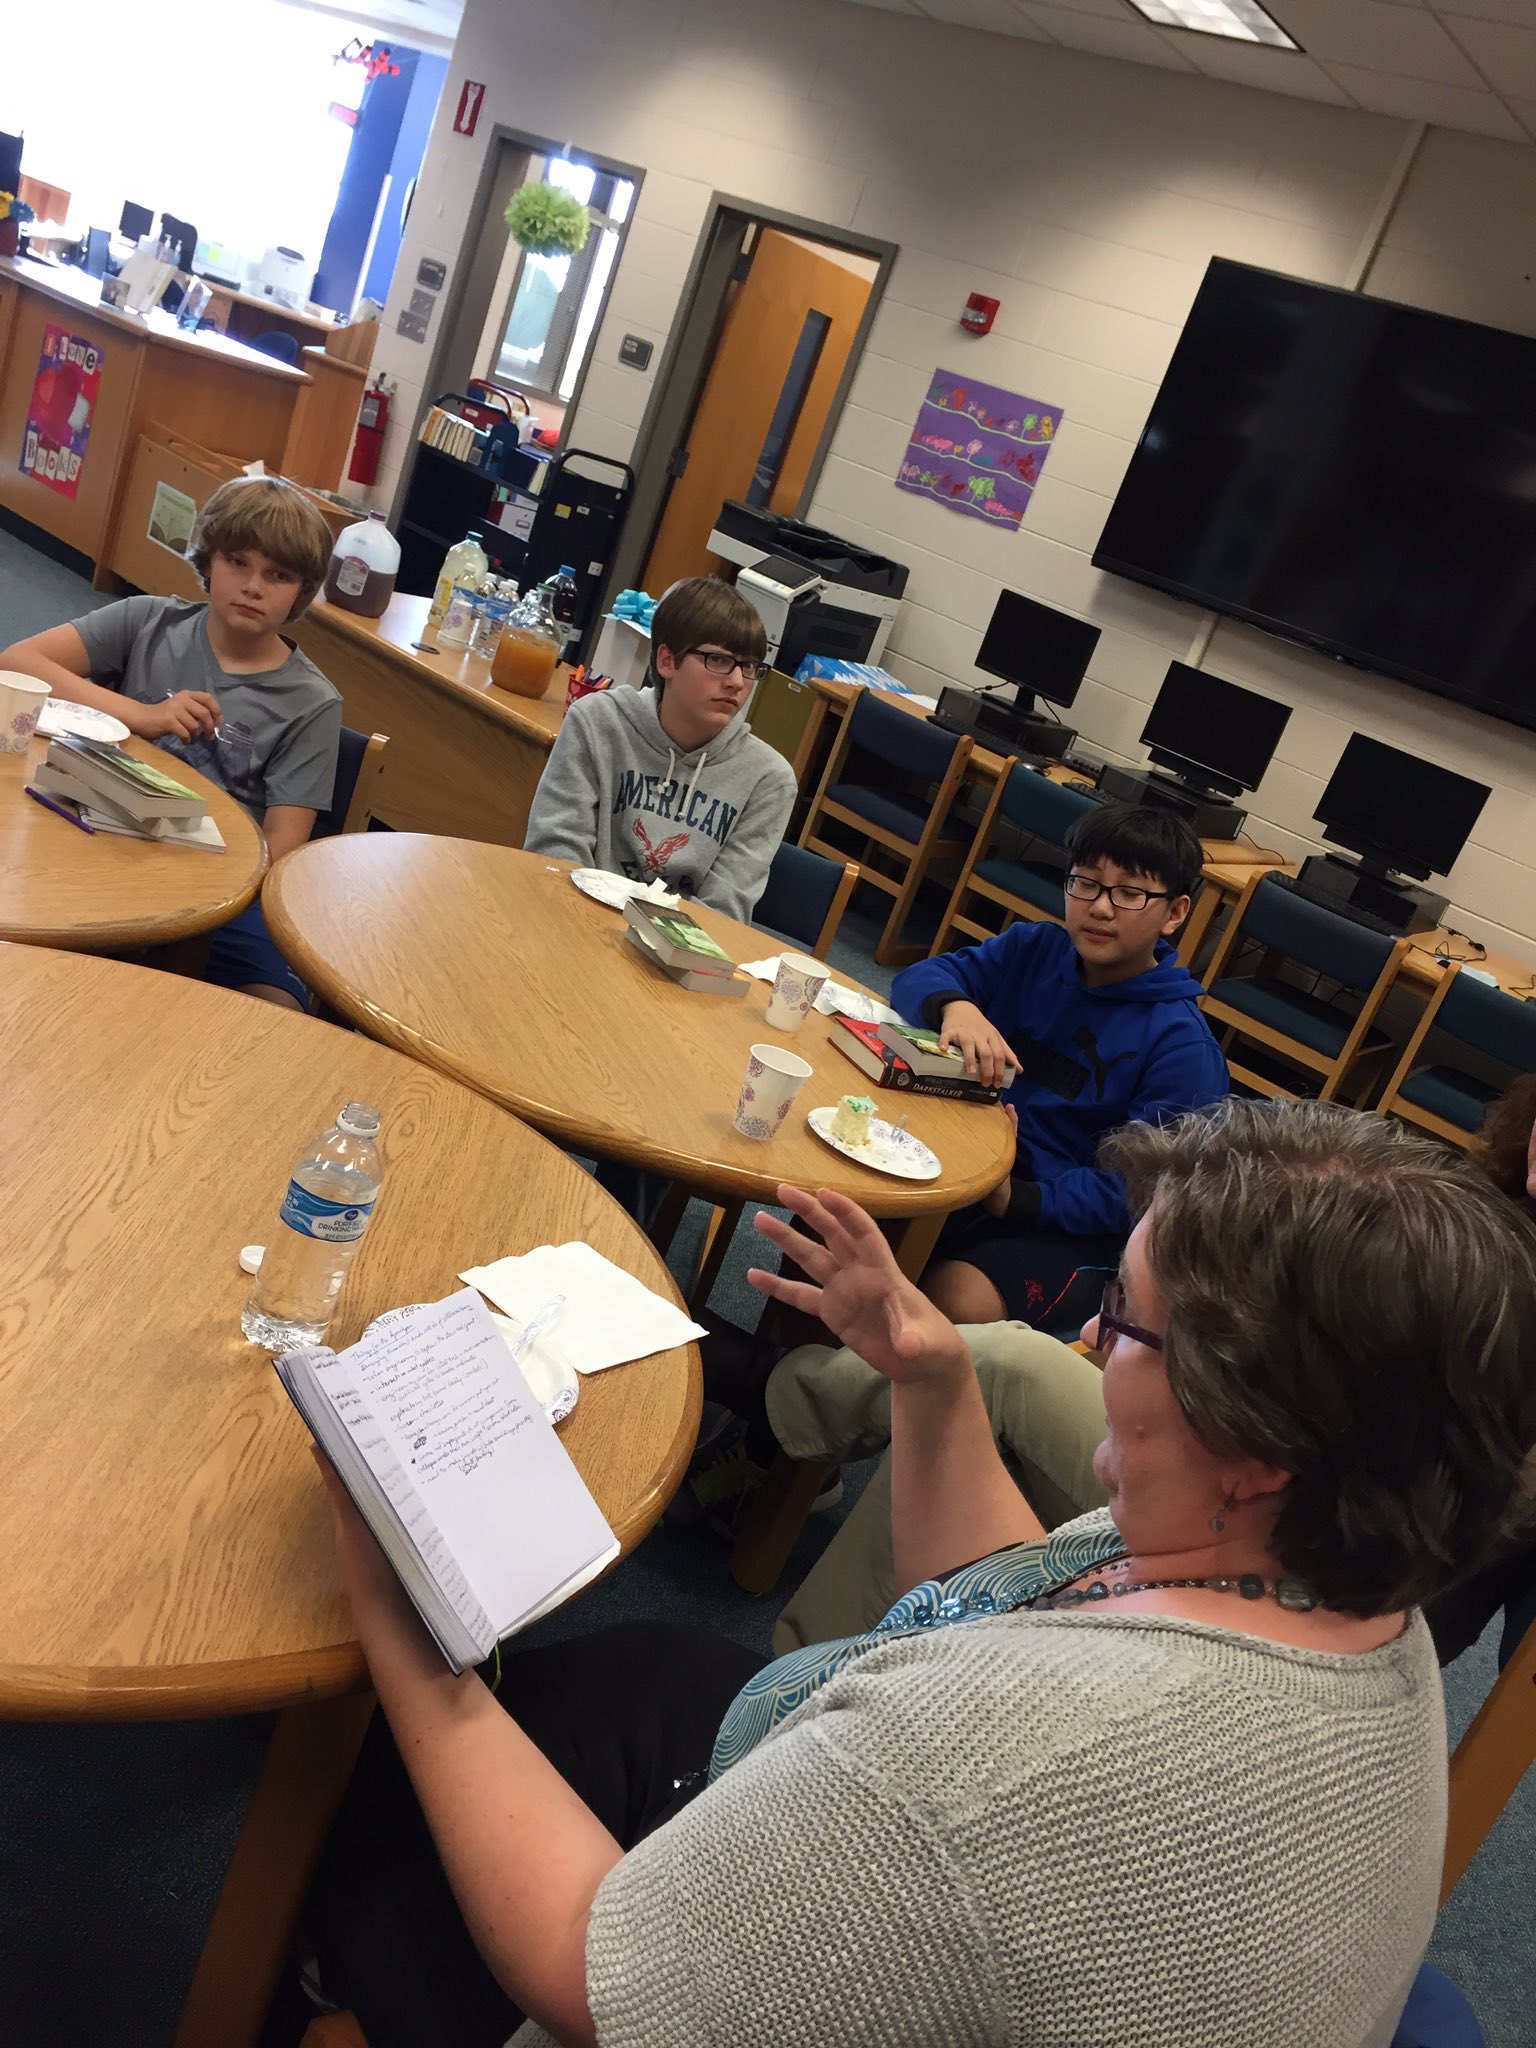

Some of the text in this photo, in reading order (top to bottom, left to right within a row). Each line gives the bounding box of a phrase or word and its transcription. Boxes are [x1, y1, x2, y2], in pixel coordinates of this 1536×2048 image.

[25, 434, 80, 479] Books
[613, 770, 737, 847] AMERICAN
[912, 1082, 963, 1098] DARKSTALKER
[318, 1223, 351, 1232] DRINKING
